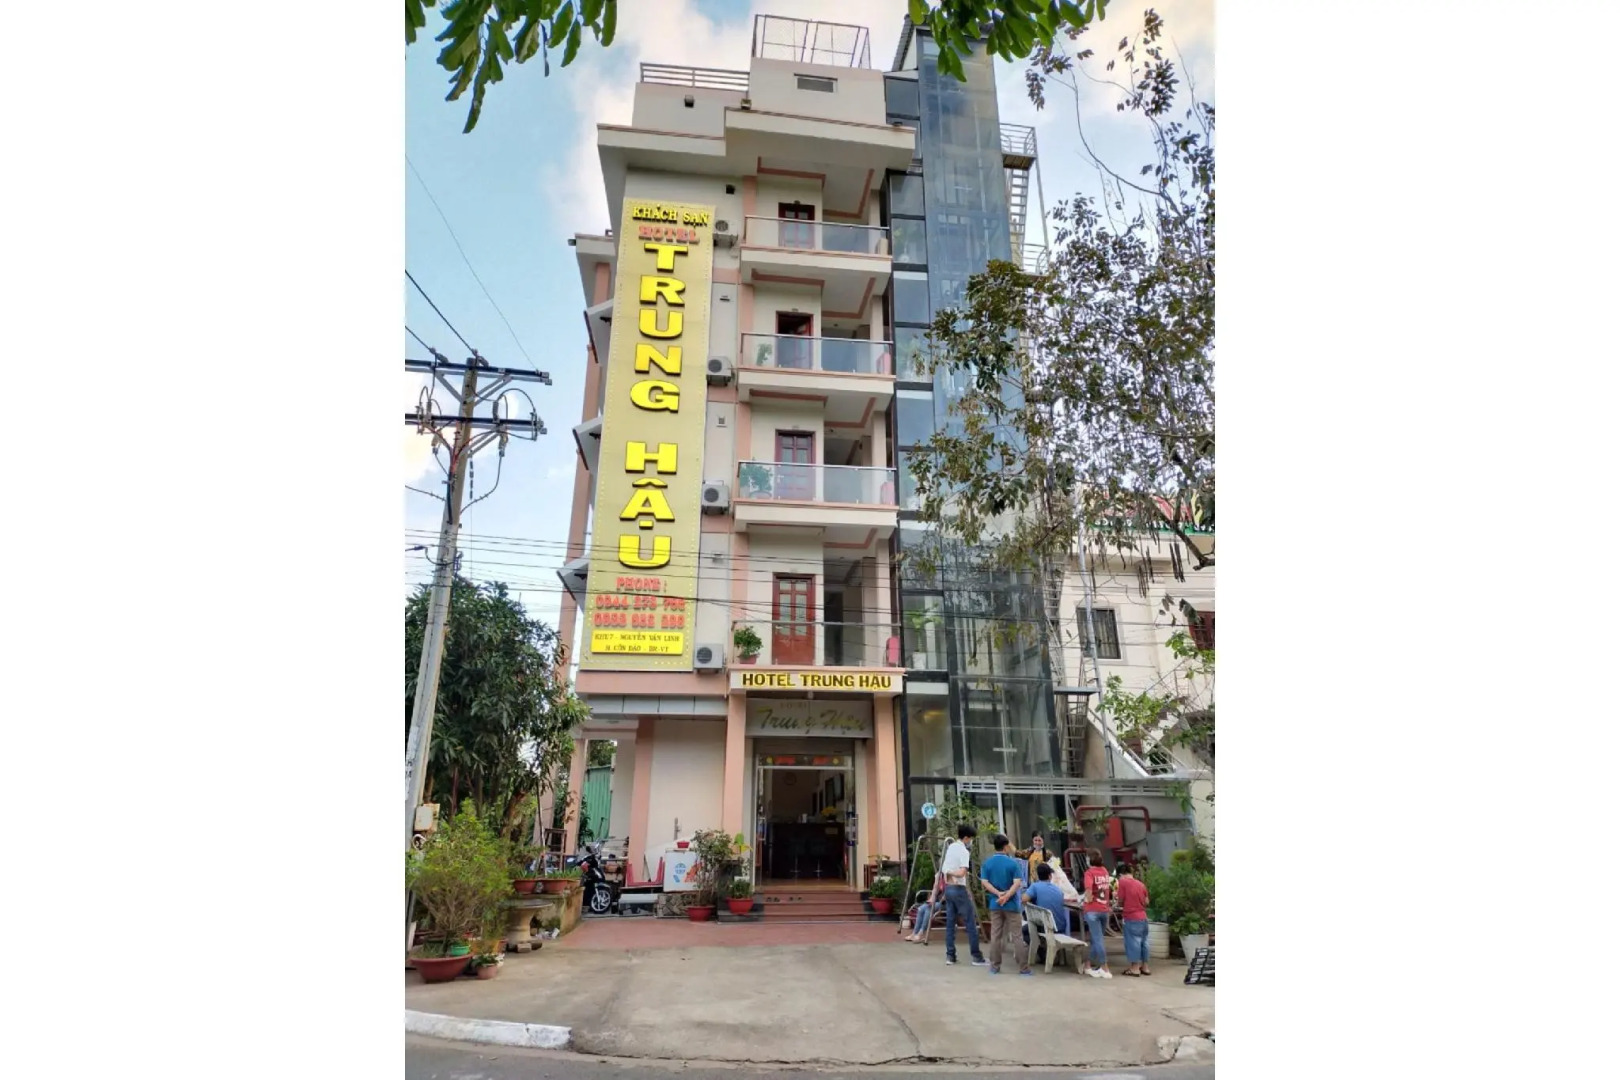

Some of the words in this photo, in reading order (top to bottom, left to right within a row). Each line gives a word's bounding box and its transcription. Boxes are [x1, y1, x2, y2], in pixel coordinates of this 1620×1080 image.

[632, 204, 677, 223] KHÁCH
[683, 209, 709, 227] SẠN
[639, 225, 700, 243] HOTEL
[630, 243, 688, 413] TRUNG
[619, 441, 678, 569] HẬU
[742, 673, 796, 687] HOTEL
[800, 673, 855, 688] TRUNG
